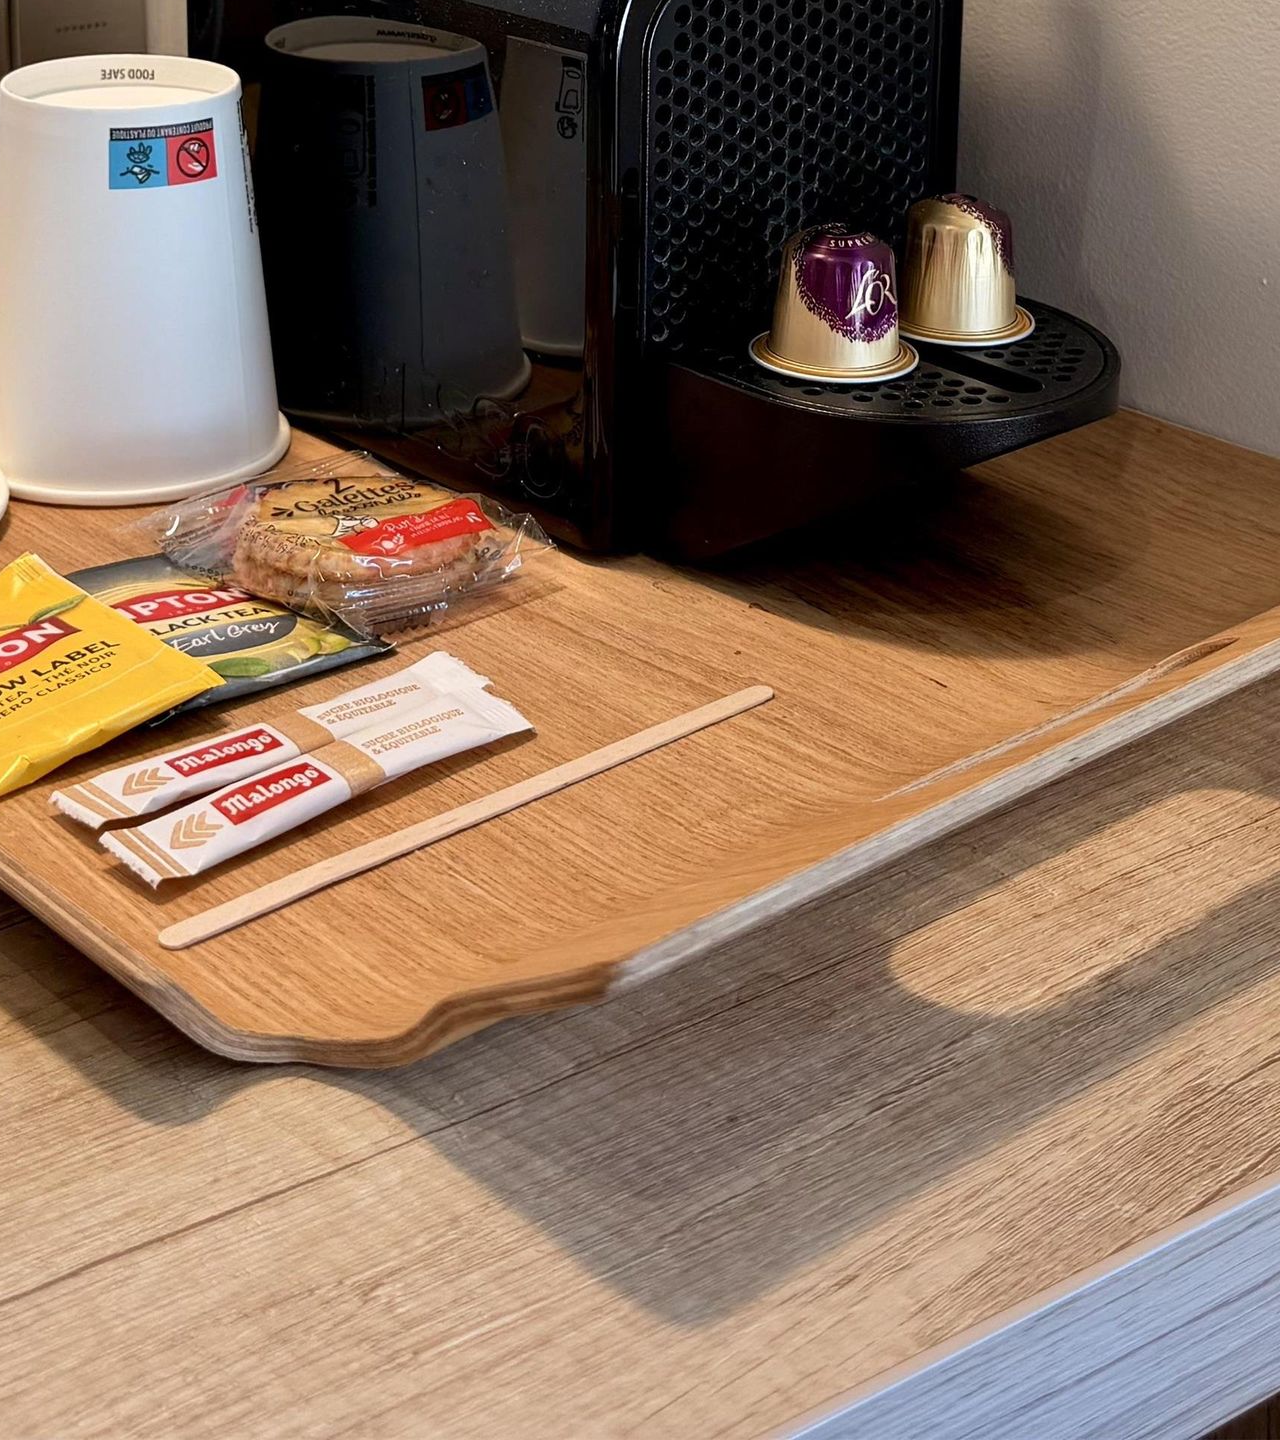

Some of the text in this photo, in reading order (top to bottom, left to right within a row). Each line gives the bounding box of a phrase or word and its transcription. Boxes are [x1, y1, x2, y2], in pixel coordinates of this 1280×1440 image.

[100, 68, 155, 81] FOOD SAFE
[844, 268, 897, 320] L'OR
[294, 481, 415, 513] Galettes
[323, 478, 356, 495] 2
[116, 586, 249, 620] IPTON
[149, 607, 270, 636] LACK TEA
[169, 621, 280, 655] Earl Grey
[31, 640, 121, 677] LABEL
[77, 651, 117, 669] NOIR
[35, 662, 113, 698] CLASSICO
[317, 683, 422, 721] SUCRE BIOLOGIQUE
[326, 699, 397, 725] & ÉQUITABLE
[361, 708, 465, 749] SUCRE BIOLOGIQUE
[370, 725, 442, 755] & ÉQUITABLE
[174, 734, 273, 772] Malongo
[221, 768, 320, 816] Malongo
